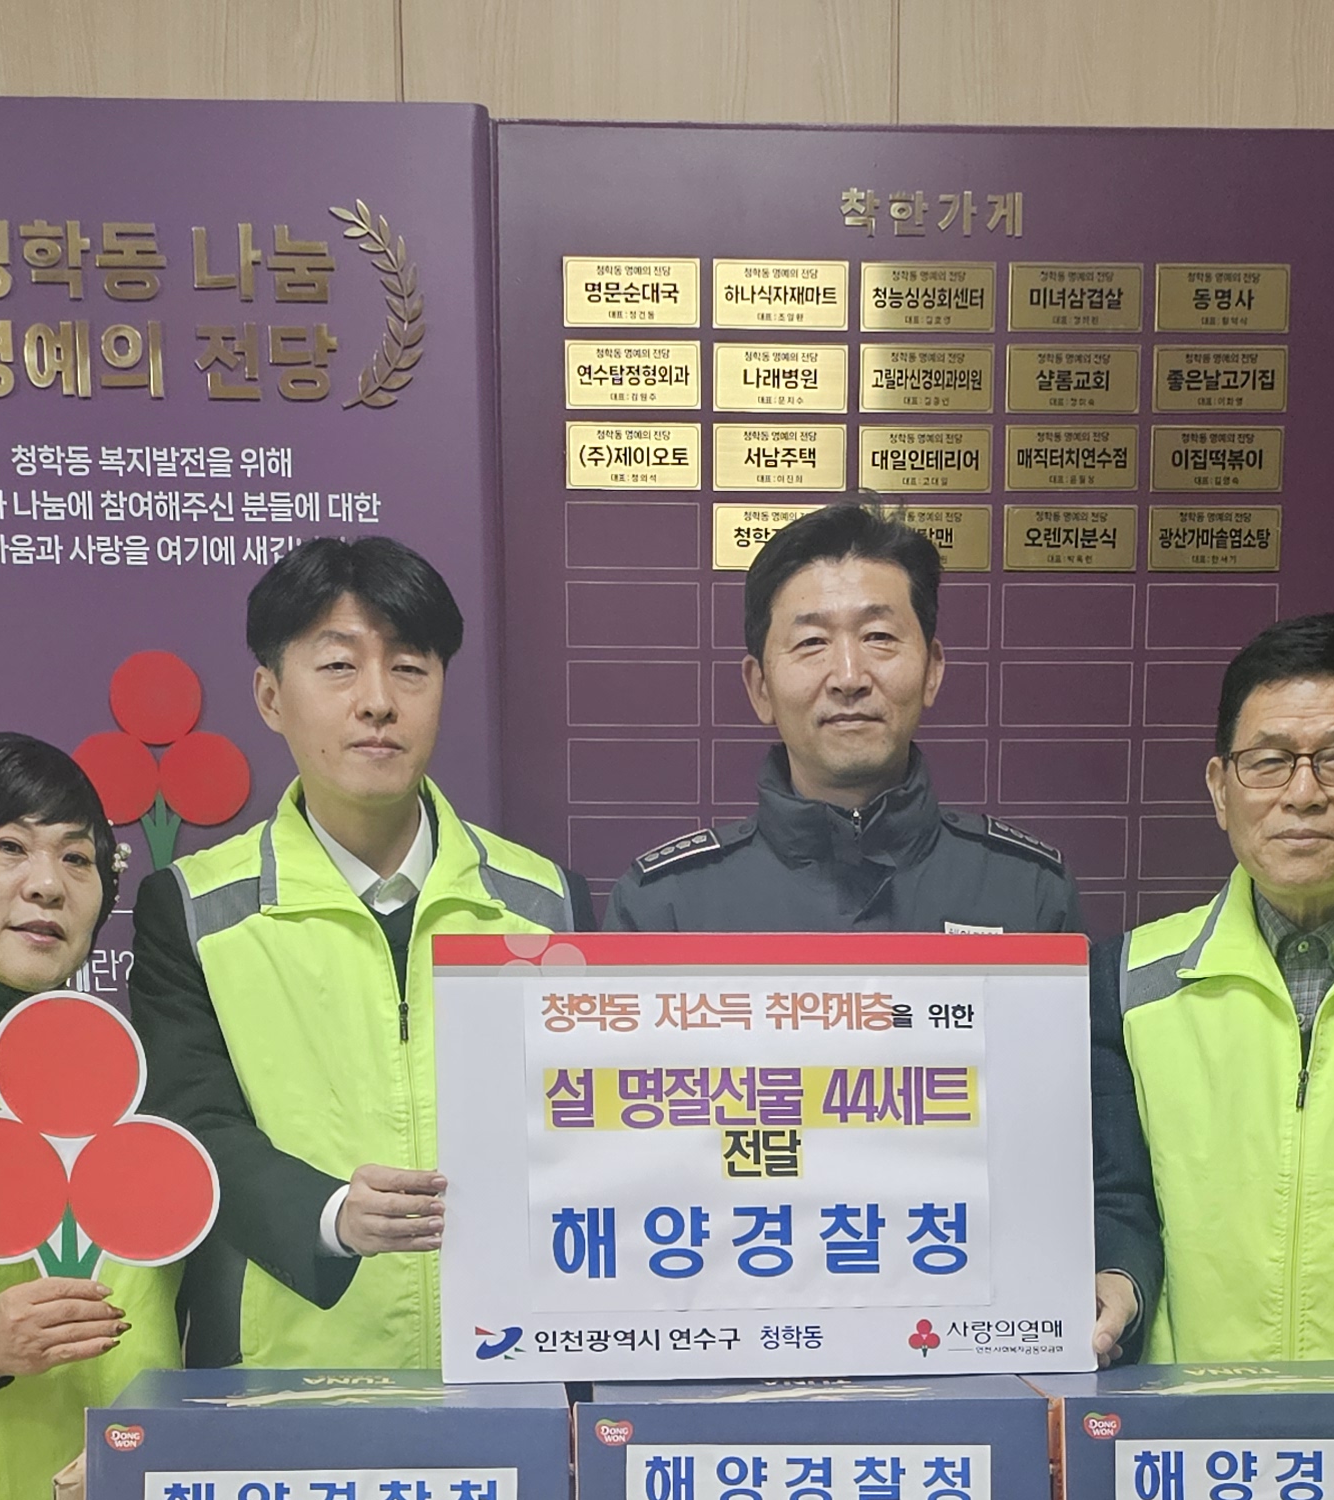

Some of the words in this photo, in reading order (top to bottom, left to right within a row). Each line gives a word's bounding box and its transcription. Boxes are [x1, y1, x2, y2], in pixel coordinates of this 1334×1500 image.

[839, 187, 1024, 239] 착한가게
[192, 222, 337, 304] 나눔
[584, 282, 680, 304] 명문순대국
[724, 285, 838, 305] 하나식자재마트
[872, 287, 984, 310] 청능싱싱회센터
[1029, 287, 1123, 310] 미녀삼겹살
[1193, 289, 1255, 310] 동명사
[195, 322, 339, 402] 전당
[577, 364, 690, 387] 연수탑정형외과
[743, 368, 818, 389] 나래병원
[871, 369, 983, 391] 고릴라신경외과의원
[1167, 369, 1276, 391] 좋은날고기집
[11, 445, 92, 478] 청학동
[98, 446, 234, 479] 복지발전을
[240, 448, 293, 479] 위해
[579, 445, 690, 468] (주)제이오토
[744, 447, 817, 469] 서남주택
[871, 449, 979, 471] 대일인테리어
[1017, 447, 1128, 470] 매직터치연수점
[1171, 449, 1263, 471] 이집떡볶이
[13, 489, 93, 522] 나눔에
[100, 490, 235, 522] 참여해주신
[241, 491, 322, 523] 분들에
[328, 491, 381, 524] 대한
[1024, 527, 1117, 549] 오렌지분식
[1159, 527, 1271, 550] 광산가마솥염소탕
[69, 534, 150, 566] 사랑을
[156, 534, 236, 566] 여기에
[541, 992, 640, 1032] 청학동
[654, 992, 751, 1031] 저소득
[765, 993, 914, 1031] 취약계층을
[928, 1002, 974, 1030] 위한
[544, 1067, 595, 1129] 설
[618, 1066, 804, 1127] 명절선물
[822, 1065, 972, 1126] 44세트
[722, 1128, 801, 1178] 전달
[533, 1327, 661, 1354] 인천광역시
[669, 1327, 741, 1353] 연수구
[759, 1324, 824, 1351] 청학동
[946, 1318, 1064, 1344] 사랑의열매
[600, 1425, 629, 1435] DONG
[1088, 1419, 1118, 1429] DONG
[1092, 1428, 1114, 1437] WON
[110, 1431, 142, 1441] DONG
[114, 1440, 137, 1449] WON
[604, 1434, 626, 1443] WON
